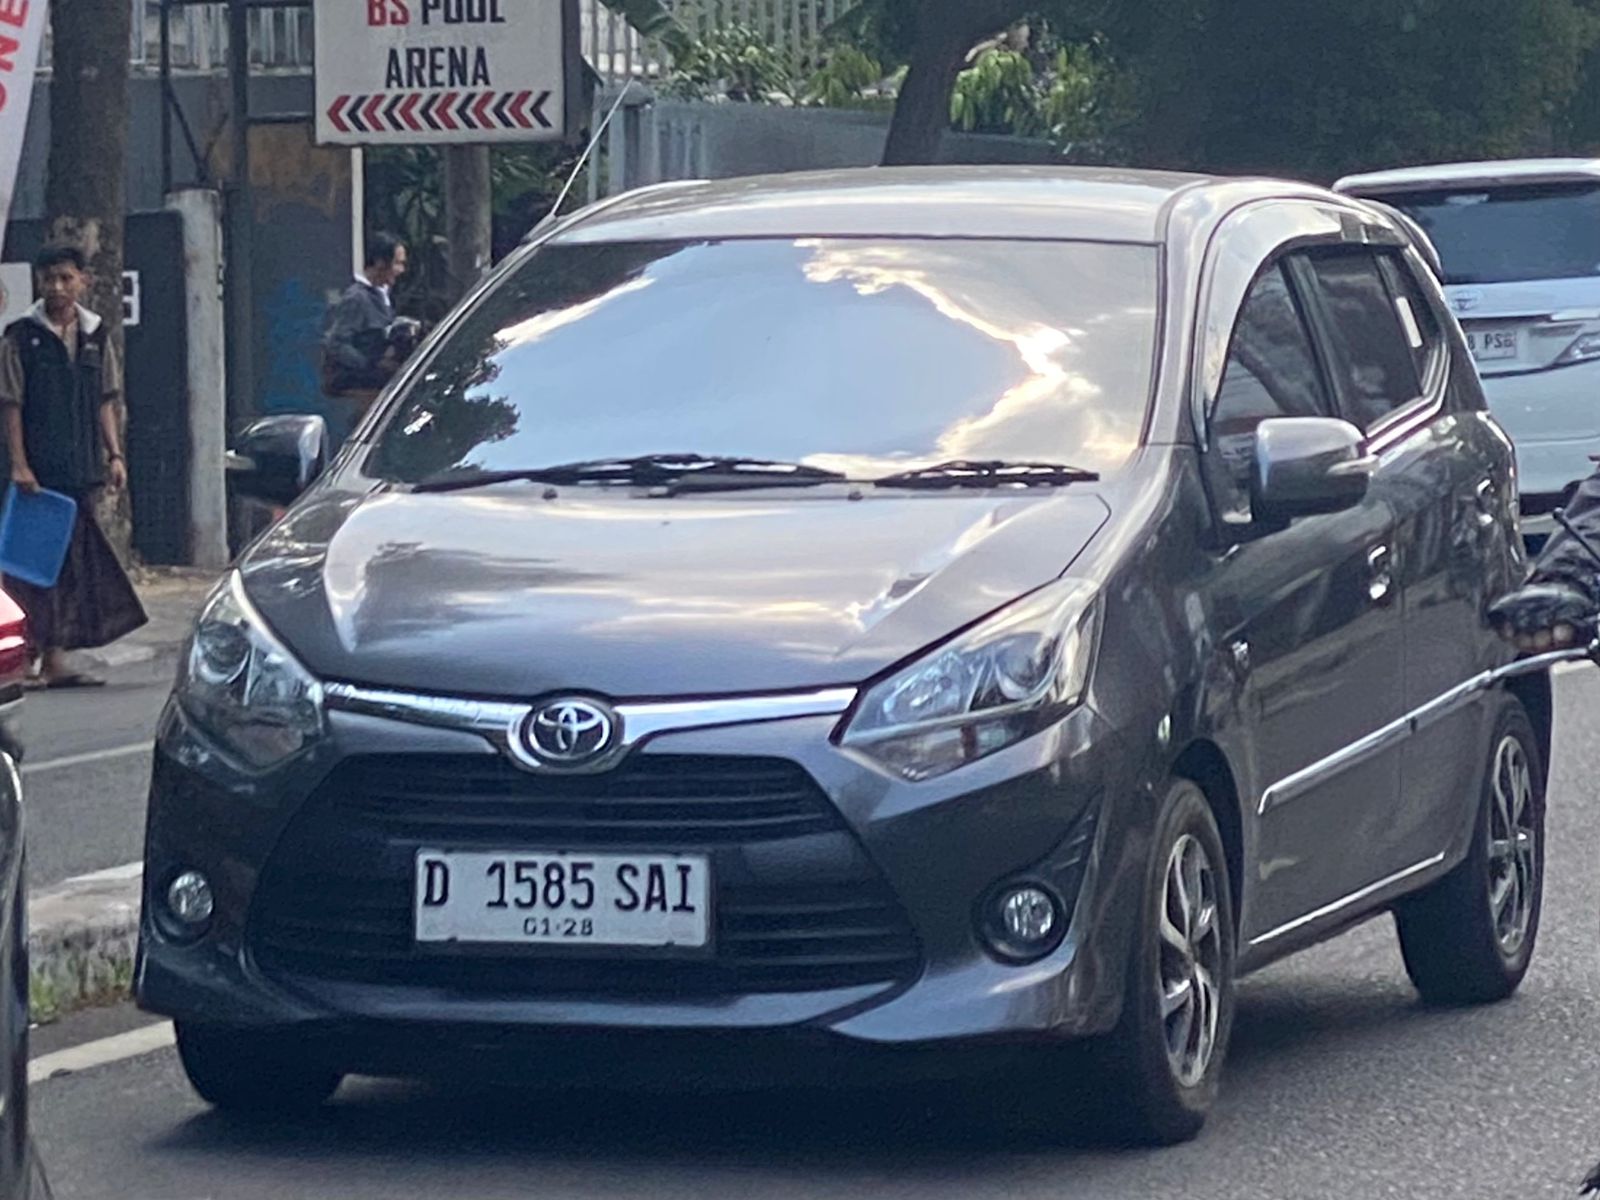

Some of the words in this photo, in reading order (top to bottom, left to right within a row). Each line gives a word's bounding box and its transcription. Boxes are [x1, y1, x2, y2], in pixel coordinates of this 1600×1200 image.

[368, 0, 410, 26] BS
[421, 0, 506, 25] POOL
[385, 46, 491, 88] ARENA
[423, 859, 449, 907] D
[486, 860, 595, 910] 1585
[614, 863, 695, 912] SAI
